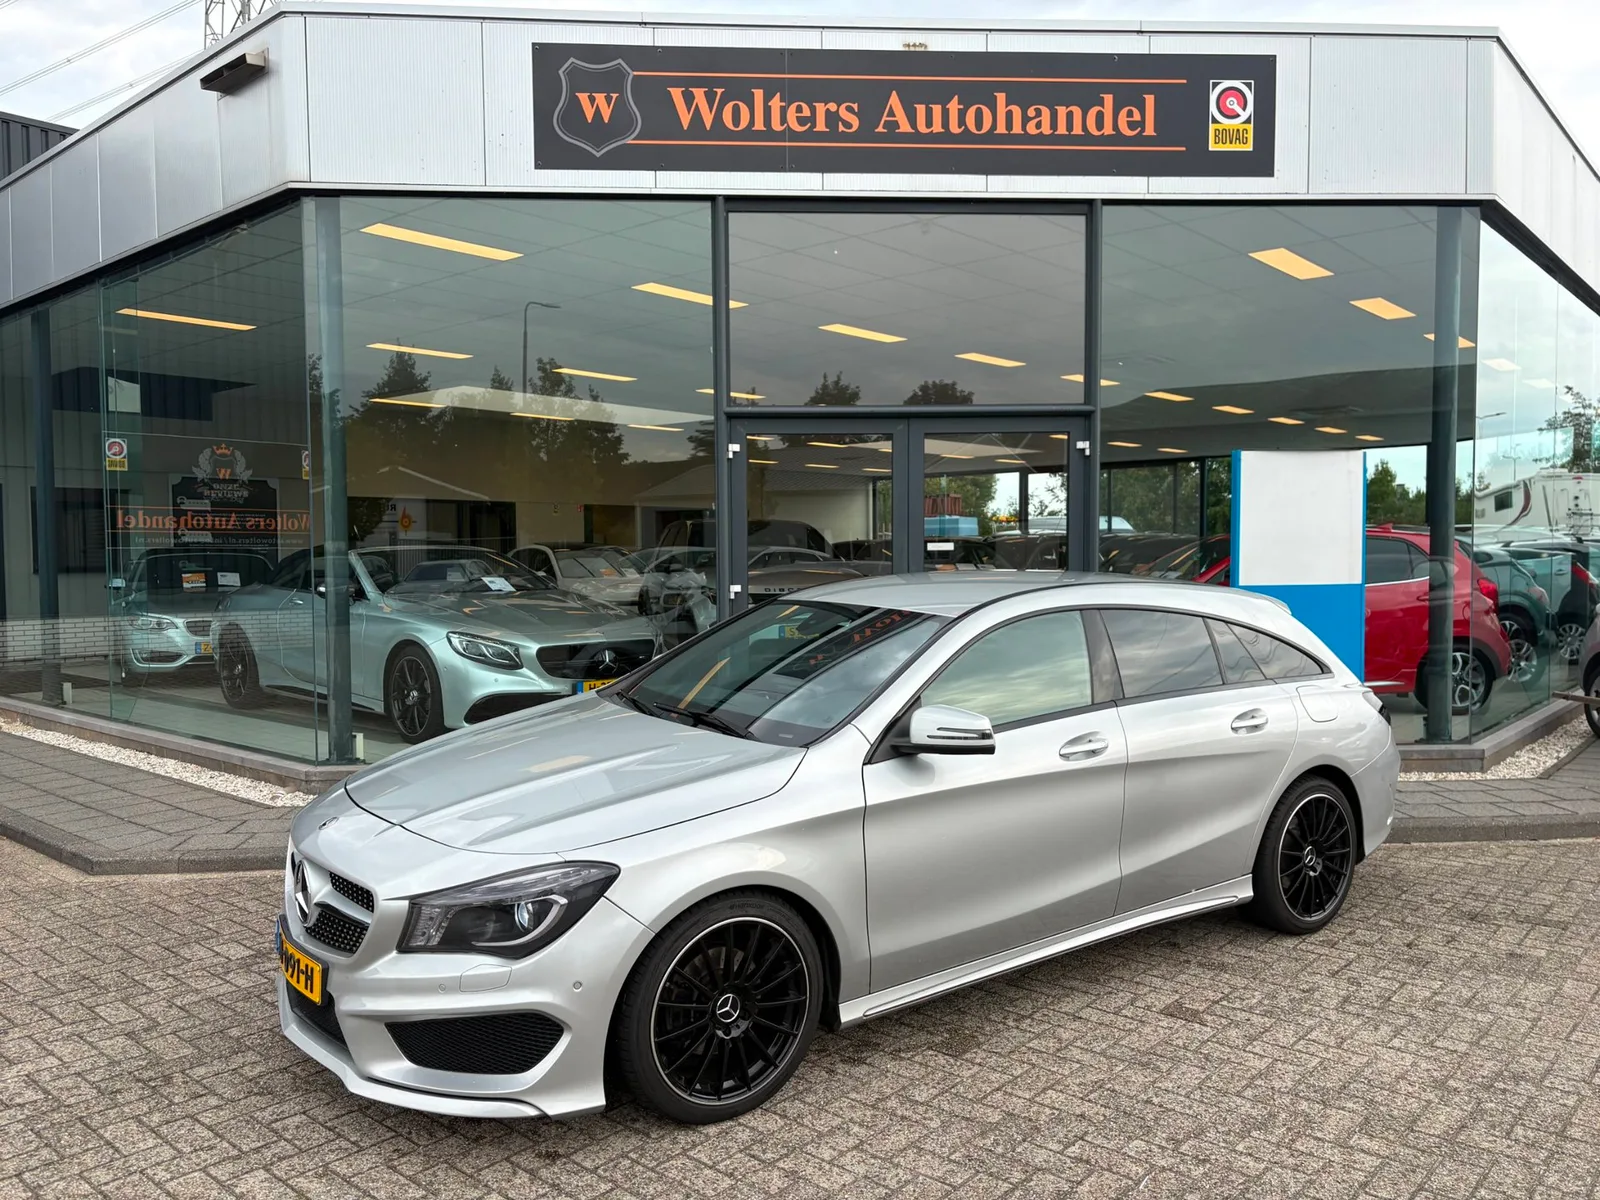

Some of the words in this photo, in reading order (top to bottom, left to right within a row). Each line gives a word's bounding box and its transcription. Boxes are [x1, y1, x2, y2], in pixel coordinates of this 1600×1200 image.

[575, 92, 620, 124] W
[667, 87, 860, 133] Wolters
[874, 90, 1157, 137] Autohandel
[1213, 127, 1249, 145] BOVAG
